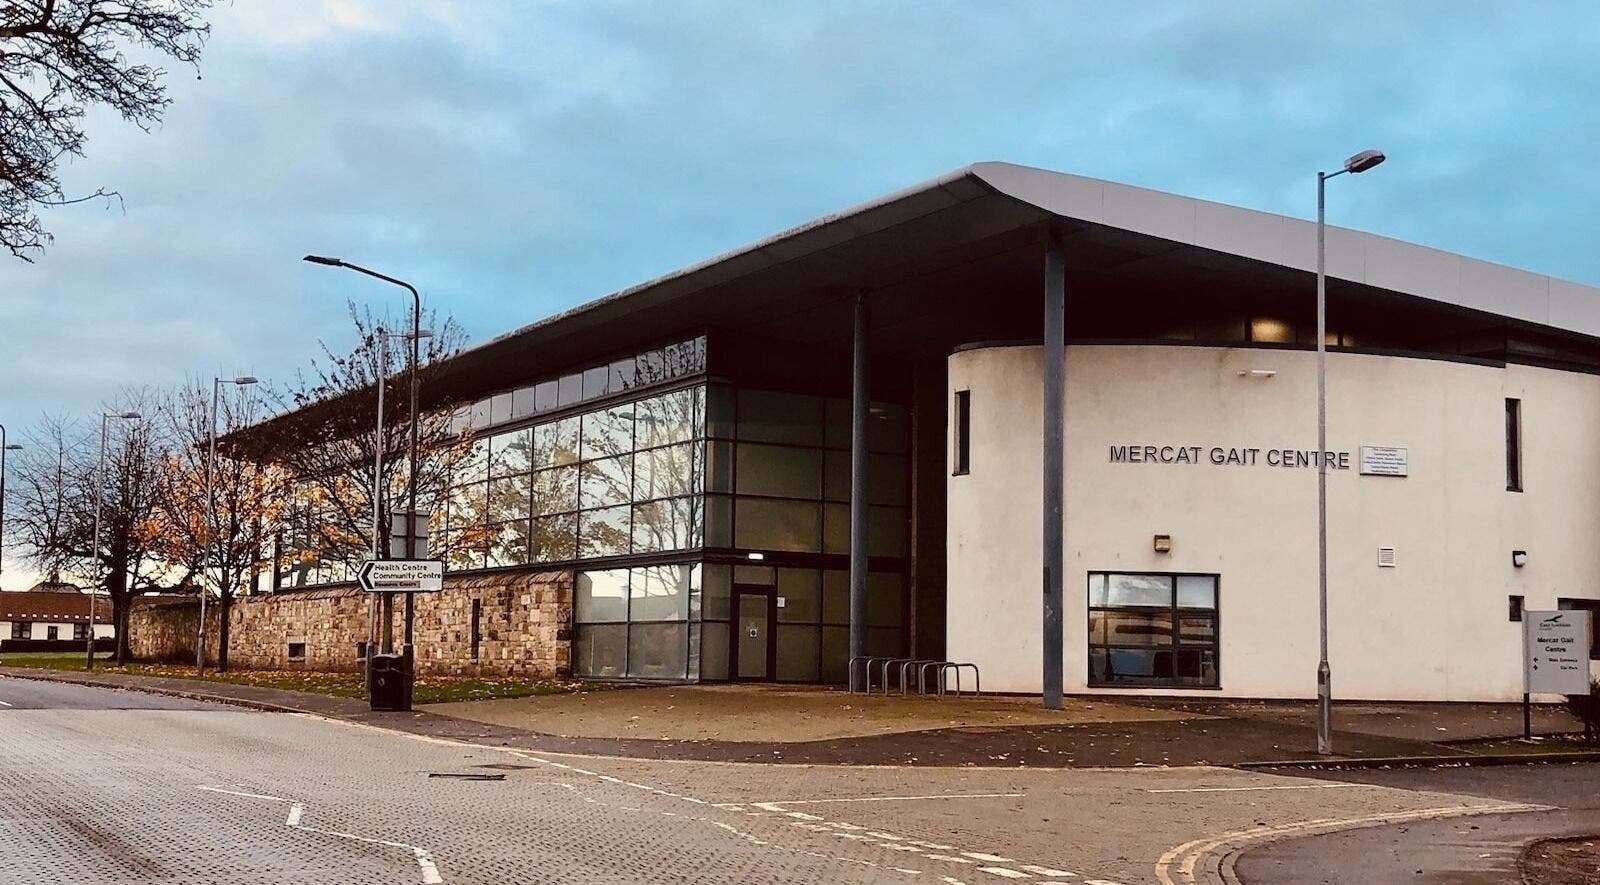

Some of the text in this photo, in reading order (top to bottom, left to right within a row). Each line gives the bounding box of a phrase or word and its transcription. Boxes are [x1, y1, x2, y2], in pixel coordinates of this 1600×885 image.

[1109, 445, 1350, 469] MERCAT GAIT CENTRE
[373, 572, 416, 580] Community
